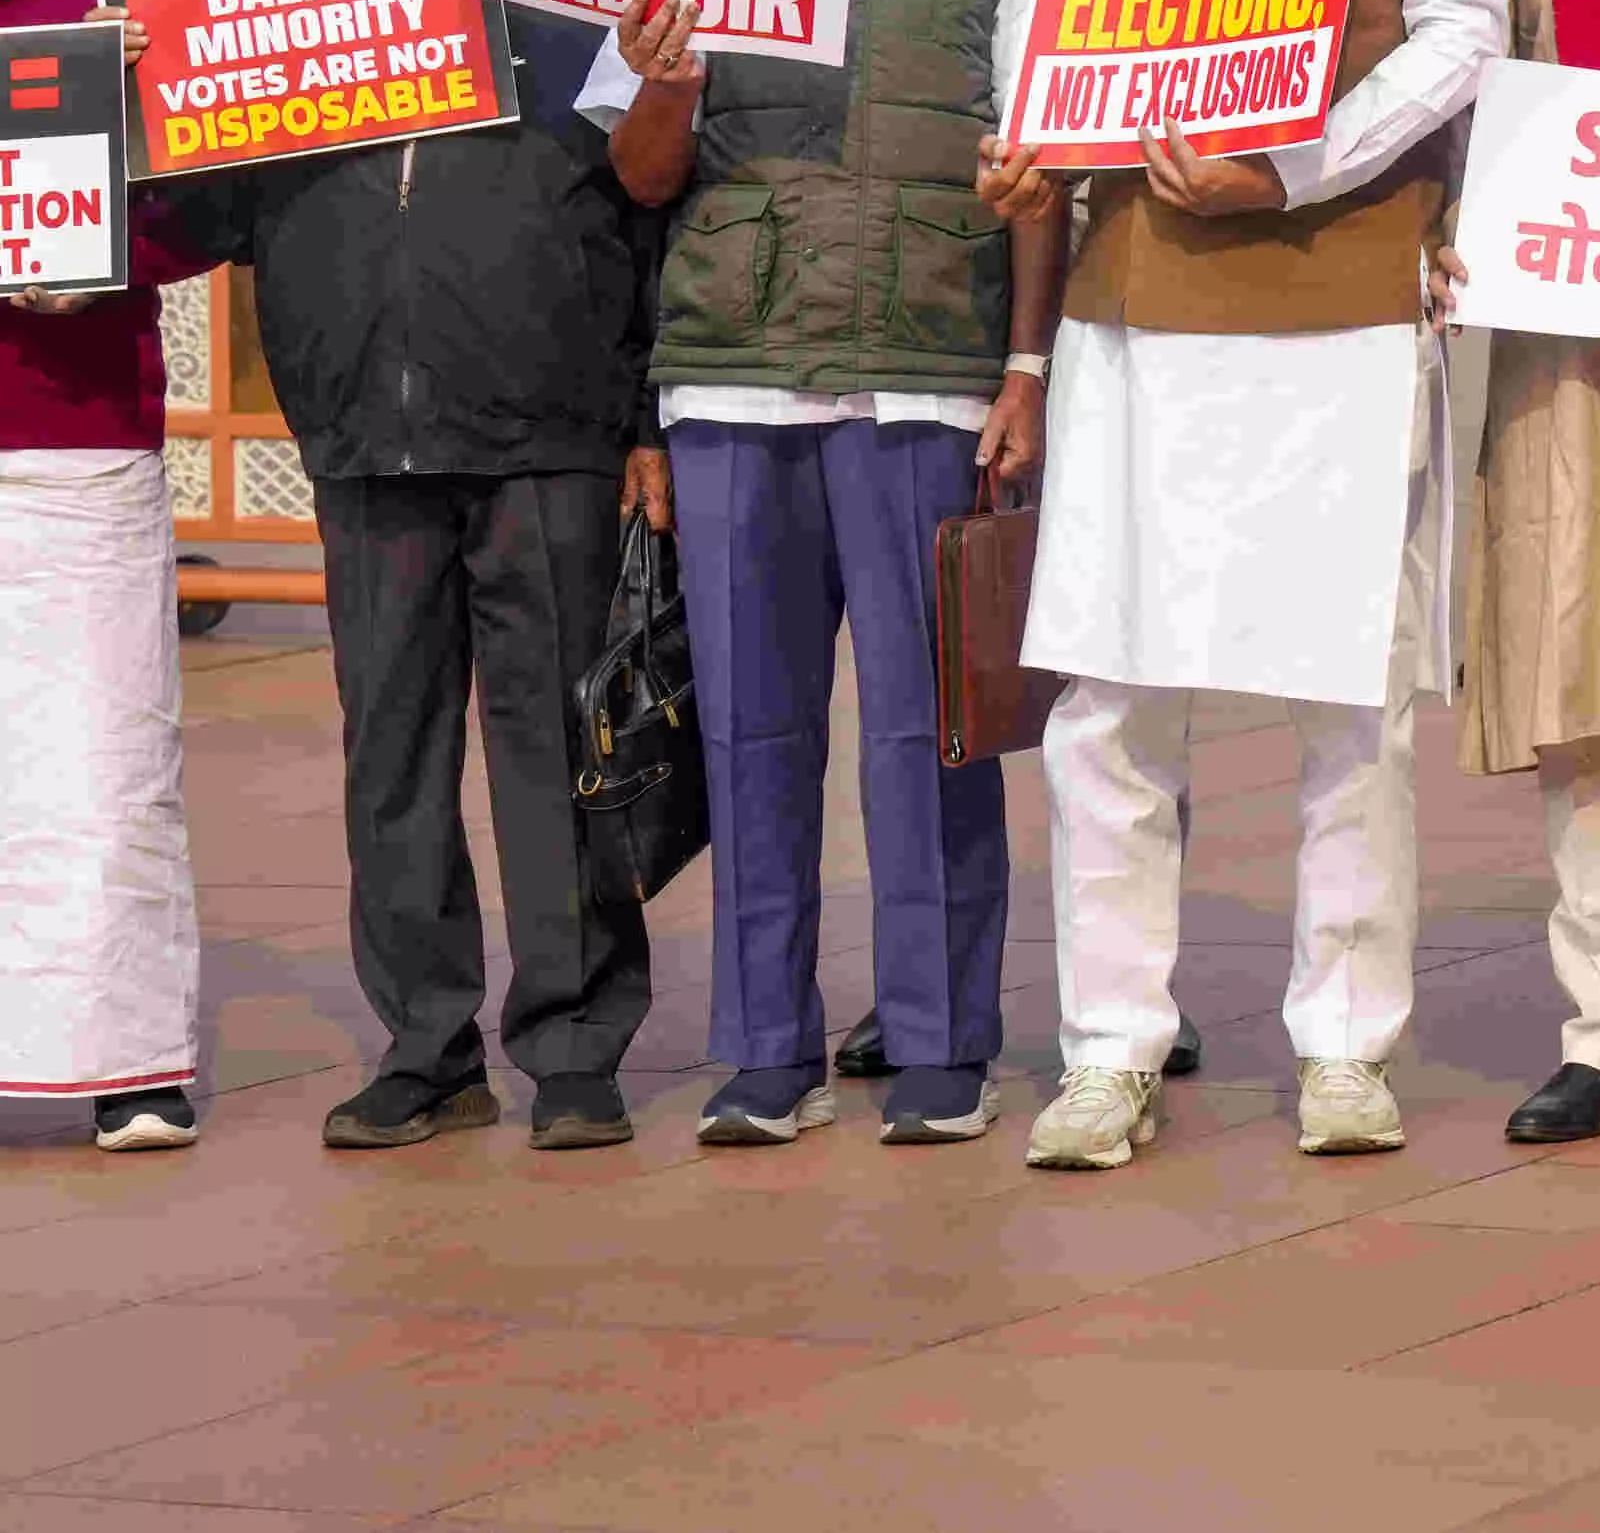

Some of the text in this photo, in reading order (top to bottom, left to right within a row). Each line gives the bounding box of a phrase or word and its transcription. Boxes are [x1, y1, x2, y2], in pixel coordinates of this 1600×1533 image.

[158, 33, 468, 113] VOTES ARE NOT
[164, 69, 478, 158] DISPOSABLE
[1040, 39, 1317, 131] NOT EXCLUSIONS
